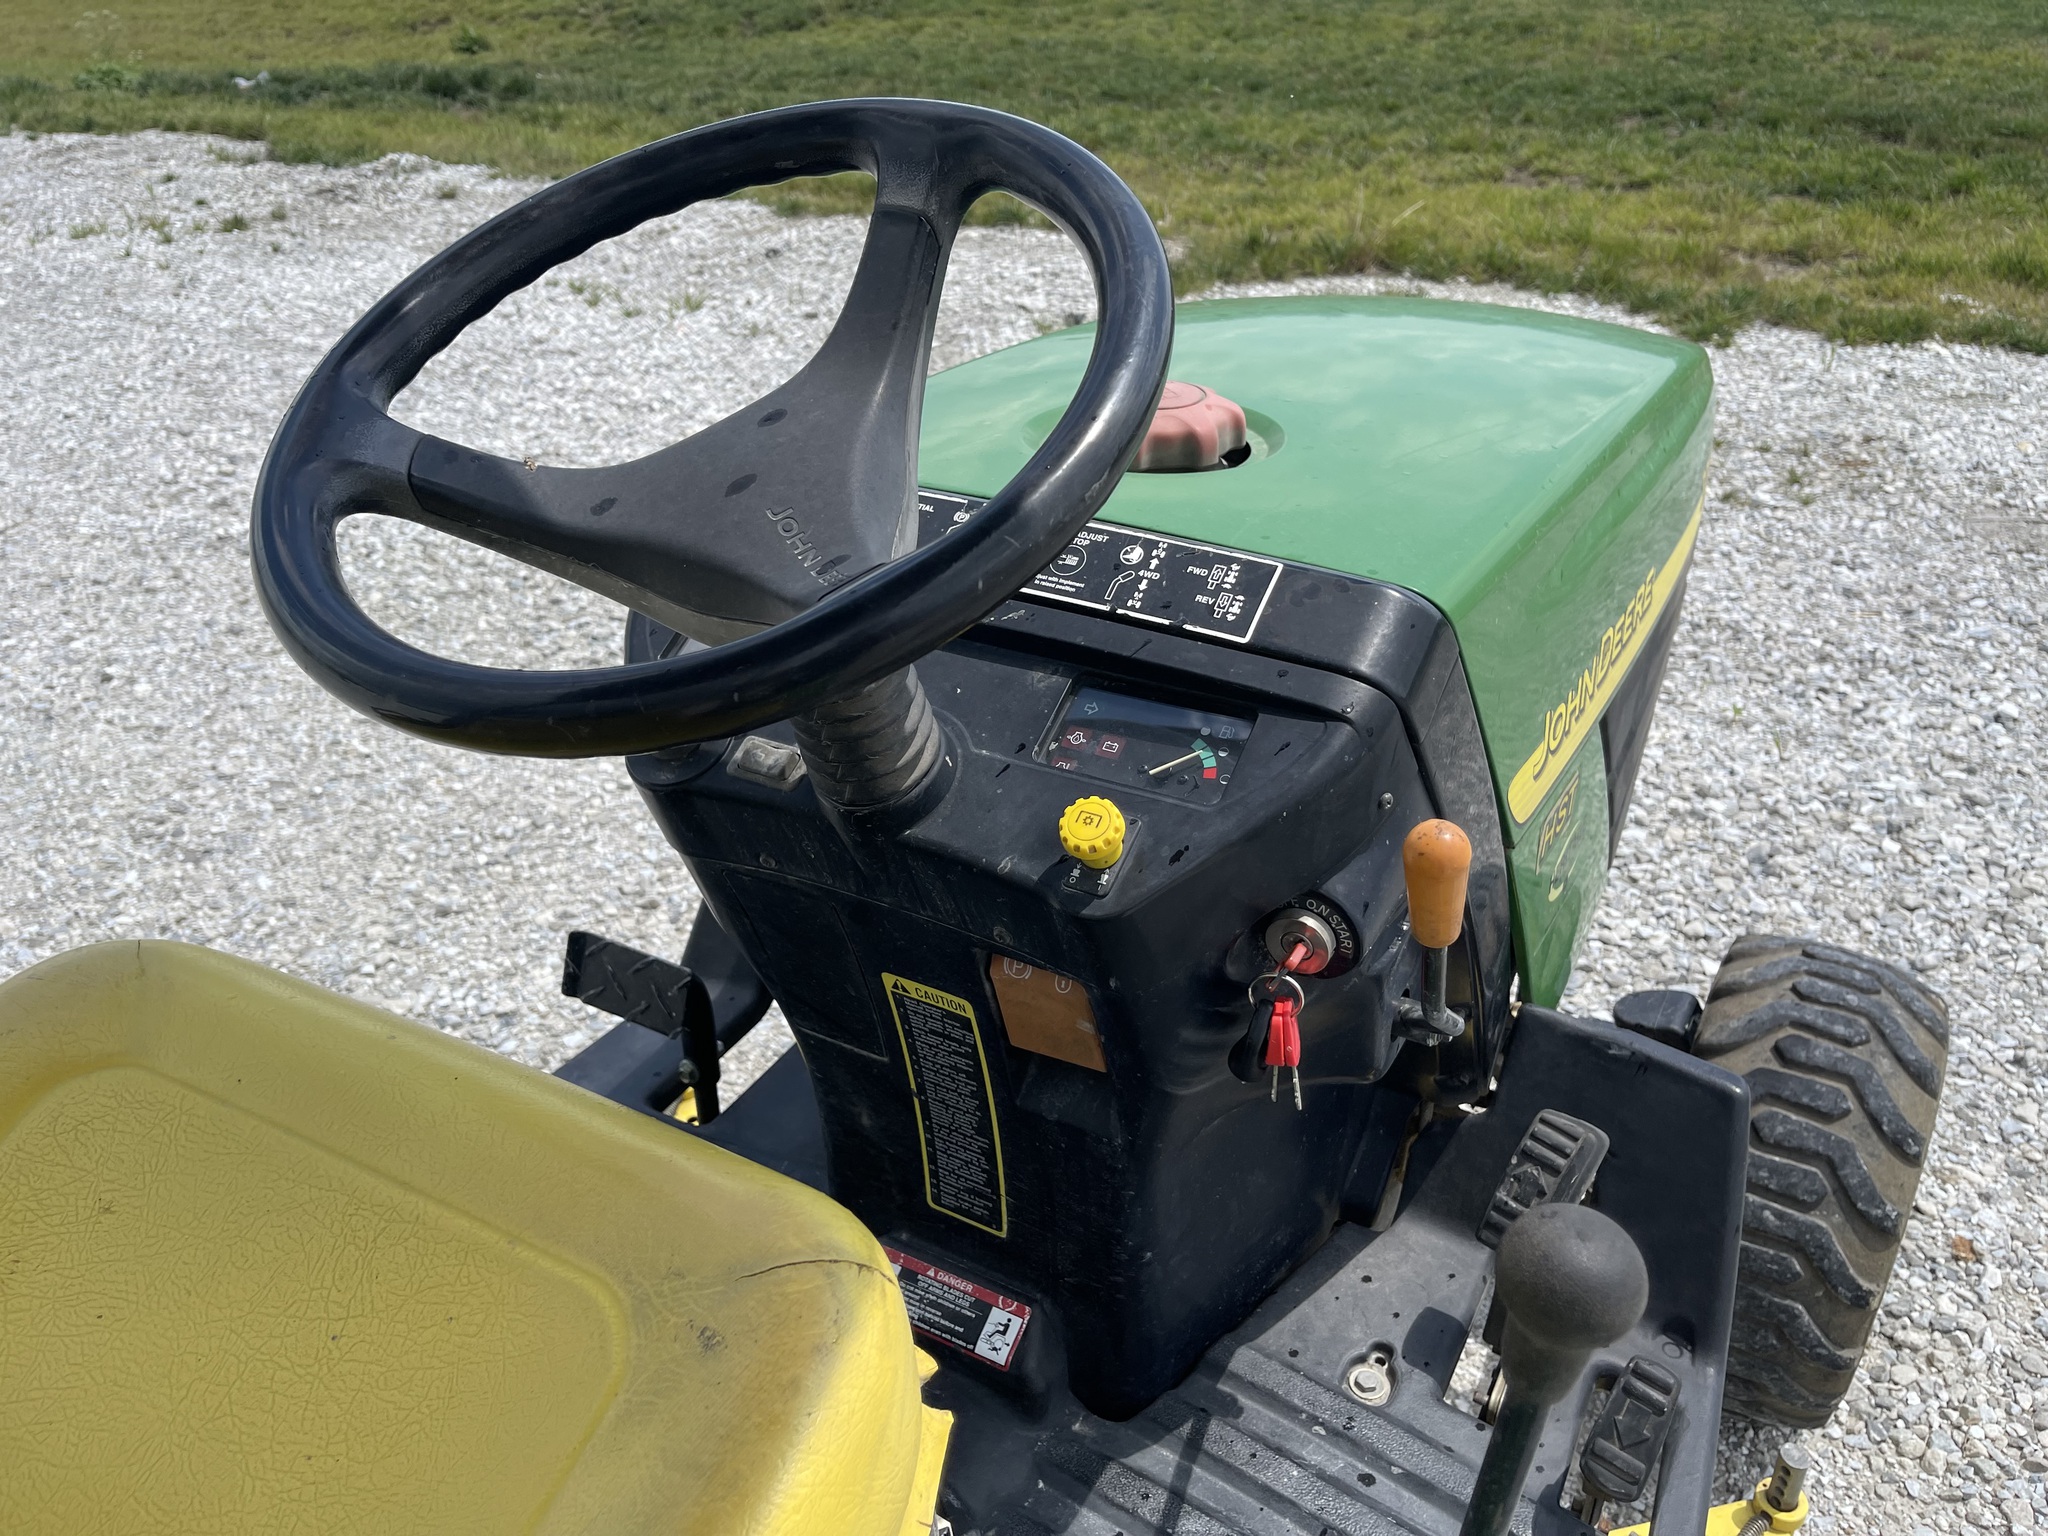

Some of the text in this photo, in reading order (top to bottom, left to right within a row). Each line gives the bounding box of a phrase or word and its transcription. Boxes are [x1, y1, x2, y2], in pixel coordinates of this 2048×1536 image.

[766, 506, 822, 568] JOHN
[1073, 537, 1090, 546] TOP
[1077, 531, 1110, 543] DJUST
[1138, 569, 1160, 580] 4WD
[1186, 565, 1208, 577] FWD
[1194, 594, 1215, 605] REV
[1533, 655, 1600, 781] JOHN
[1597, 566, 1656, 689] DEERE
[1541, 778, 1579, 859] HST
[1306, 899, 1330, 916] ON
[915, 987, 967, 1014] CAUTION
[937, 1272, 973, 1293] DANGER
[956, 1296, 970, 1307] LEGS
